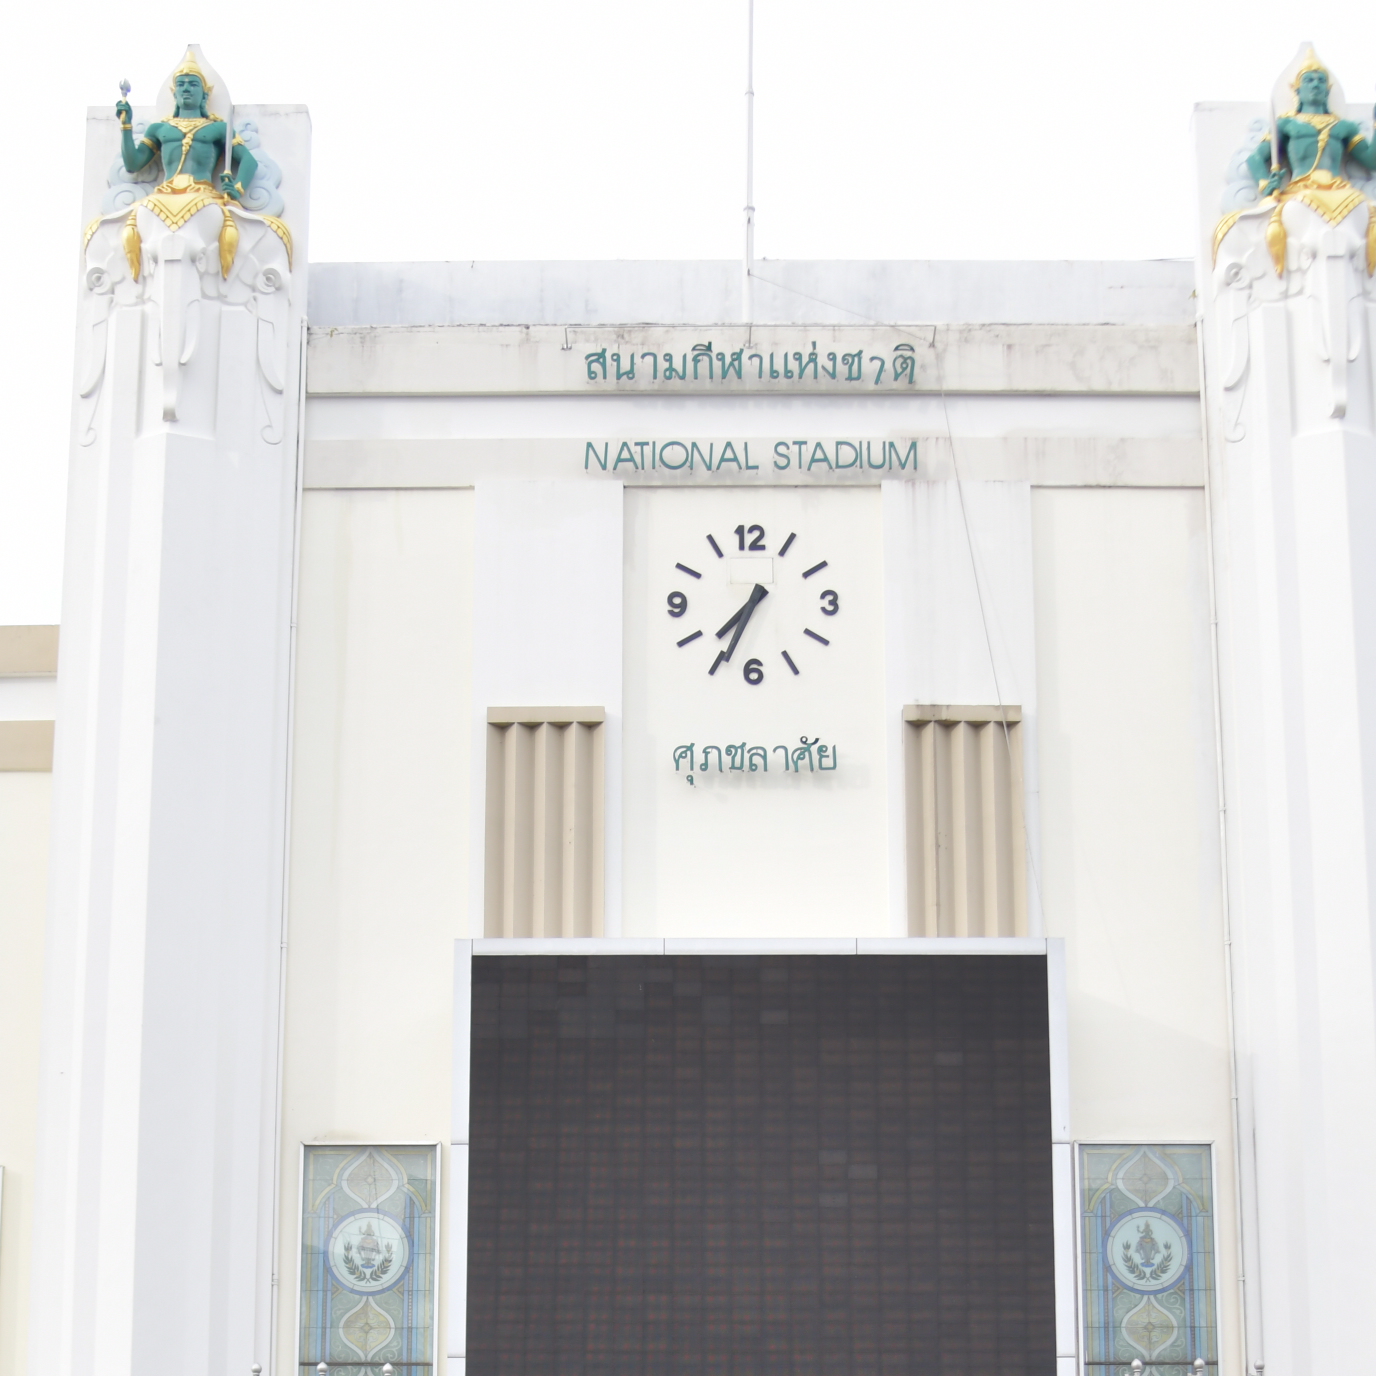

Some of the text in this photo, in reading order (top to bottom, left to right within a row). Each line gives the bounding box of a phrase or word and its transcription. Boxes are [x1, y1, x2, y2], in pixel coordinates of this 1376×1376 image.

[585, 342, 917, 385] สนามกีฬาแห่งชาติ
[584, 440, 918, 472] NATIONAL STADIUM
[734, 524, 767, 552] 12
[667, 590, 689, 618] 9
[819, 589, 840, 617] 3
[742, 657, 765, 686] 6
[673, 735, 838, 786] ศุภชลาศัย
